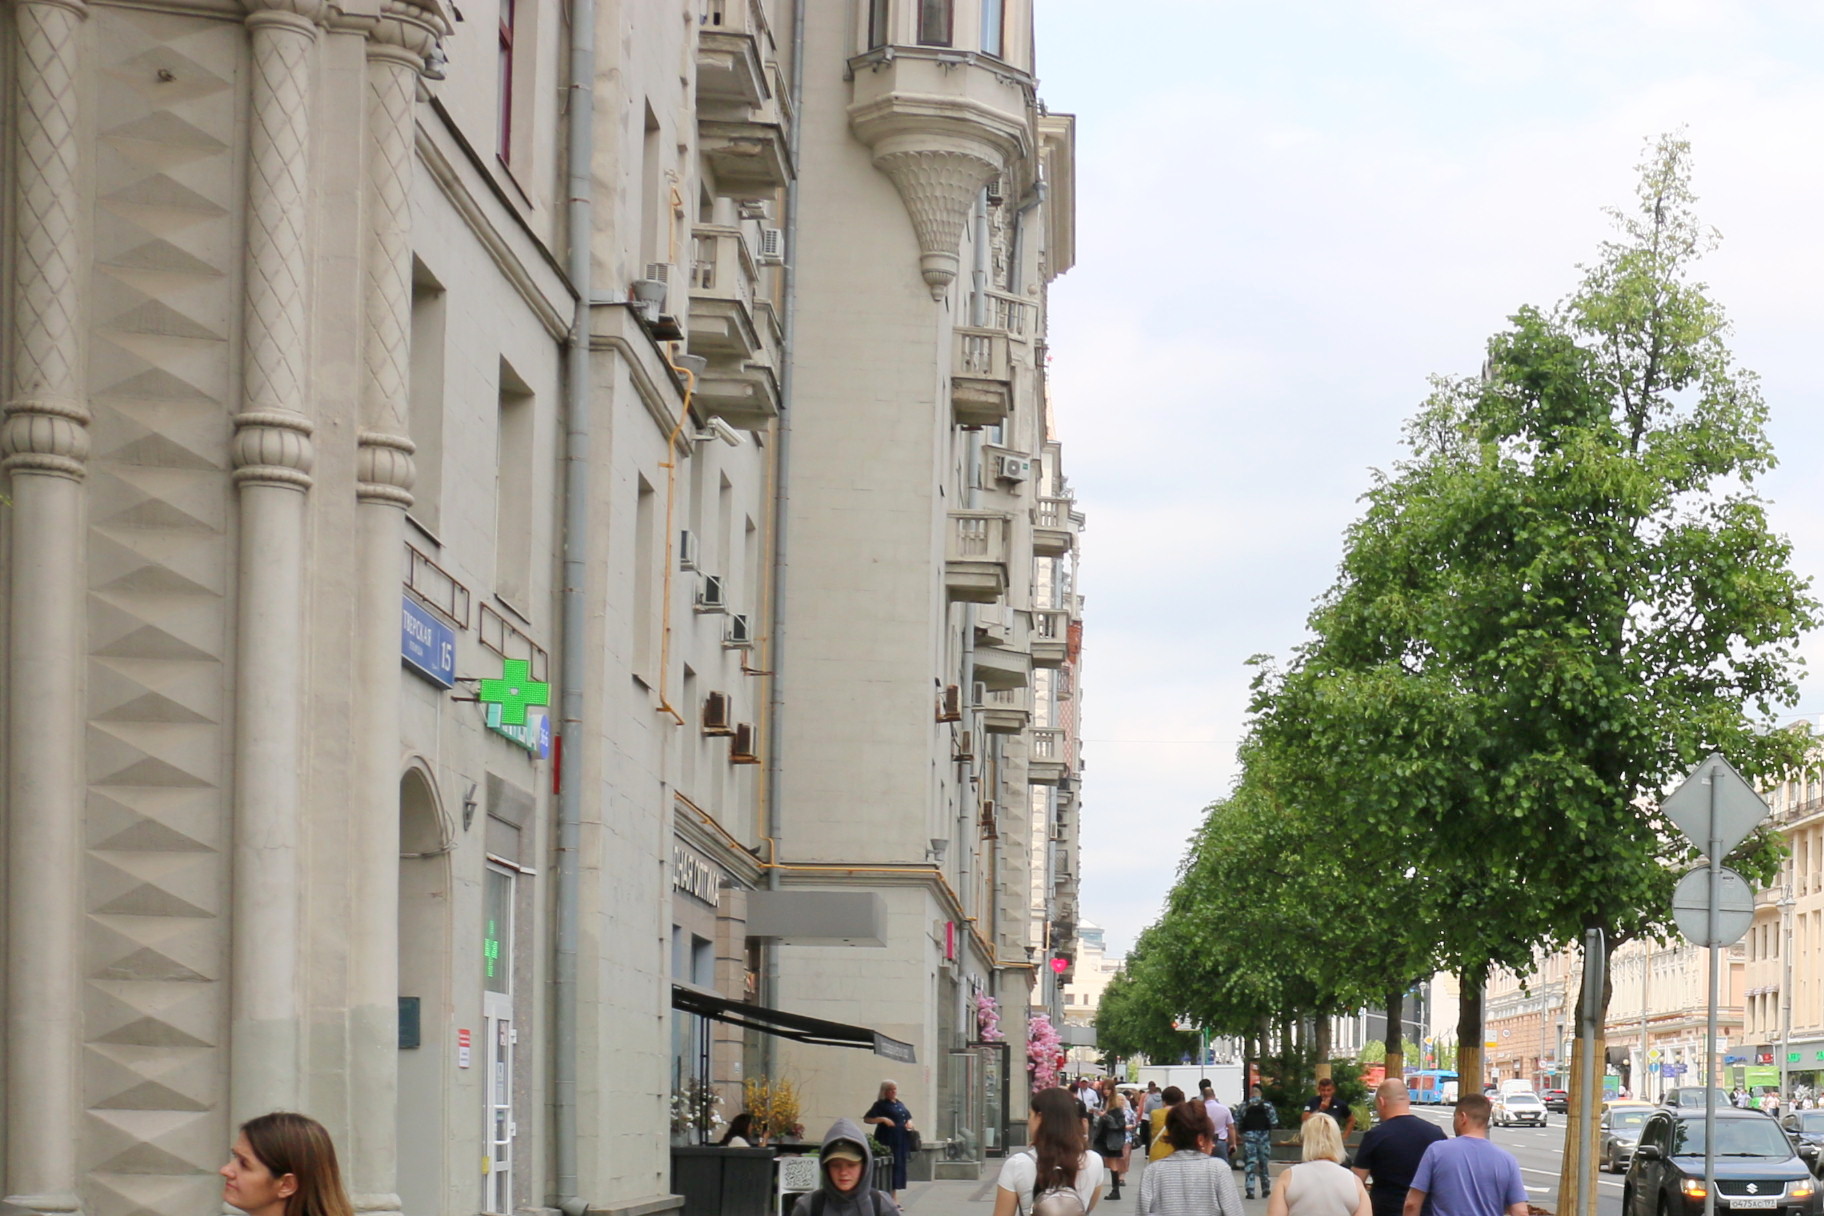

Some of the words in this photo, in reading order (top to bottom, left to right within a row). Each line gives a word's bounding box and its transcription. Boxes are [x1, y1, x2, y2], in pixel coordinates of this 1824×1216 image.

[403, 609, 433, 648] ТВЕРСКАЯ
[441, 641, 452, 672] 15
[694, 859, 720, 909] ОПТИКА
